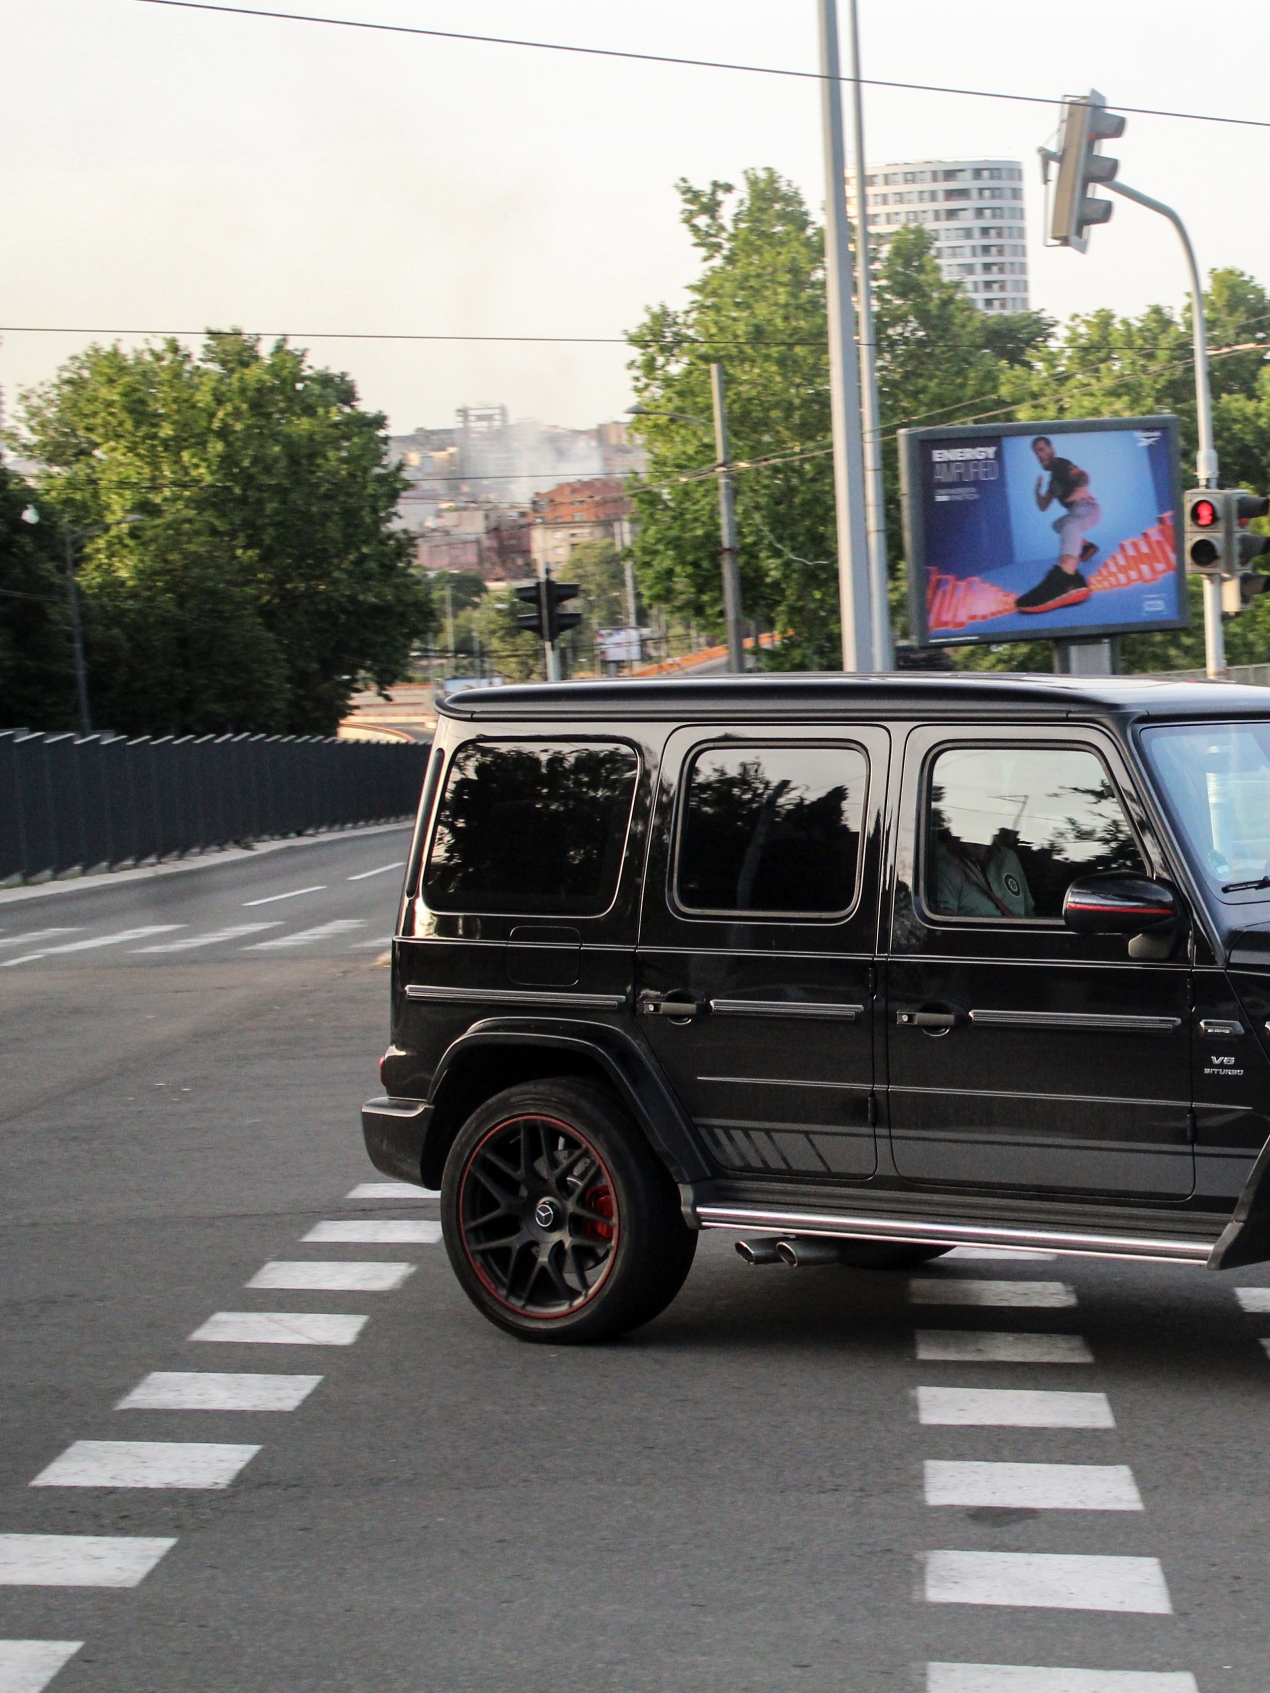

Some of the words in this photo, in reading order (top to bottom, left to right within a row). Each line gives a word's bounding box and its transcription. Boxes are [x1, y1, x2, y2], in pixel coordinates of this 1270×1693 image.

[932, 447, 998, 462] ENERGY
[933, 460, 999, 482] AMPLIFIED
[1203, 1068, 1244, 1076] BITURBO
